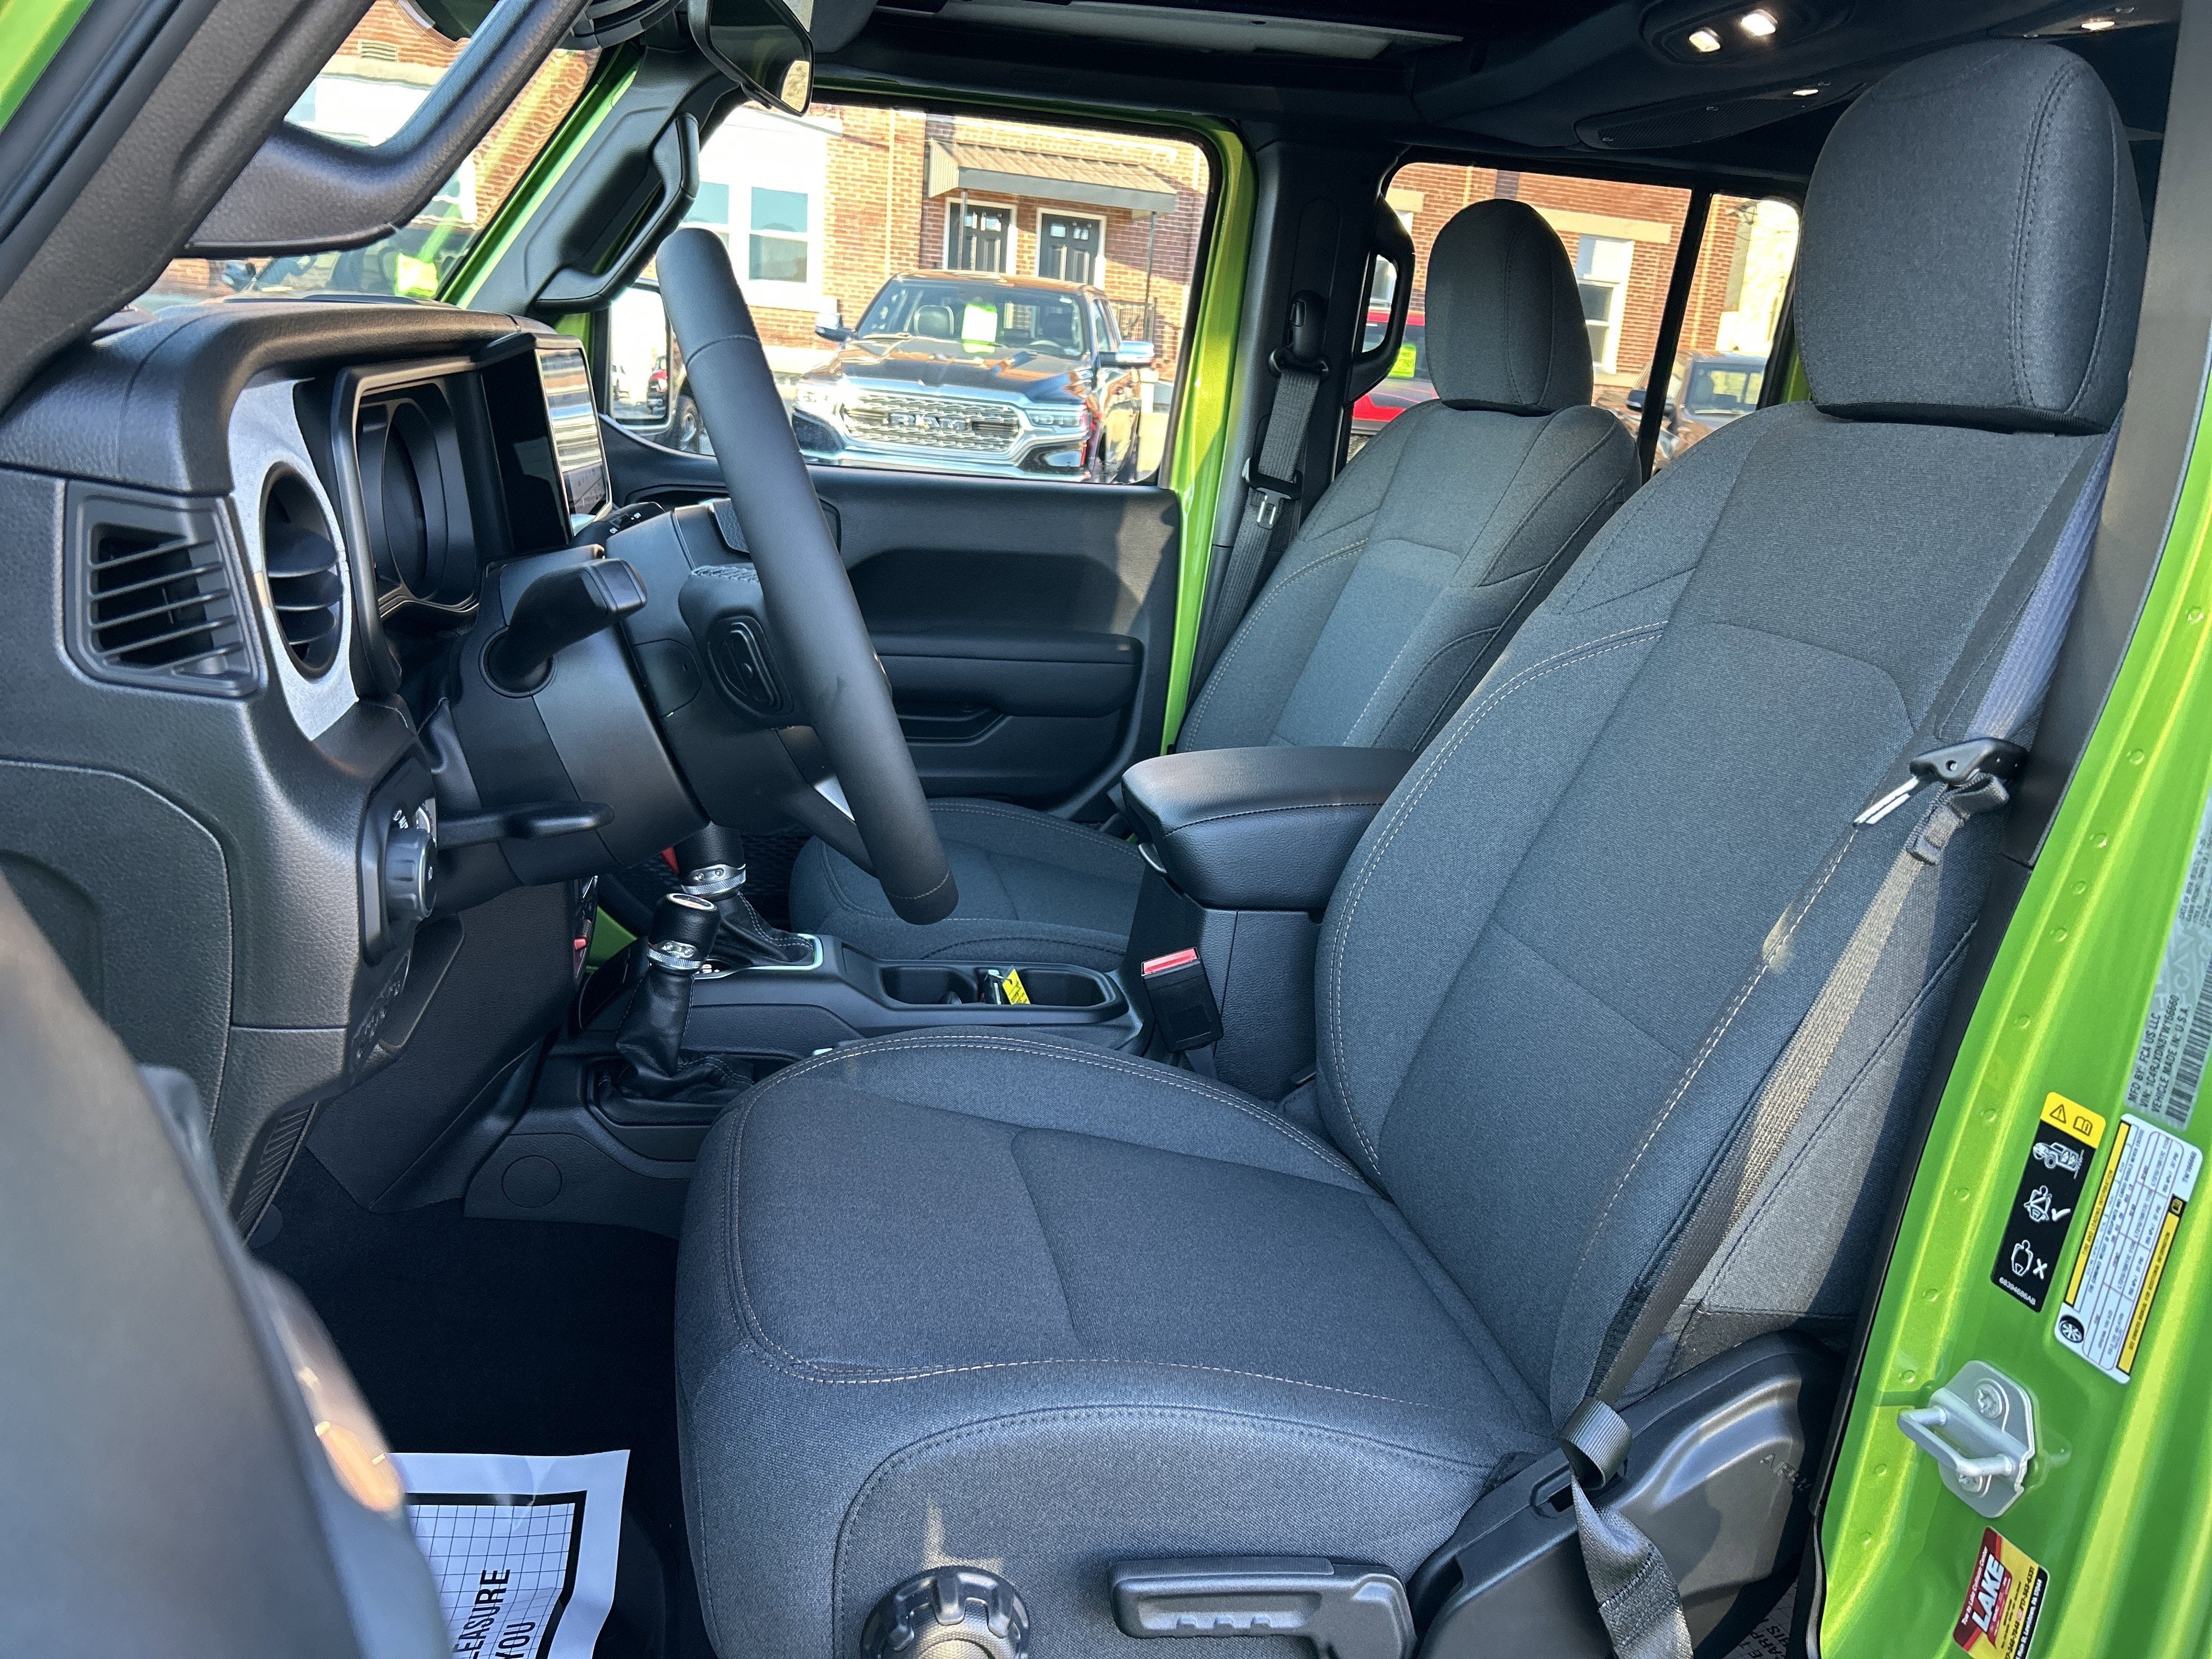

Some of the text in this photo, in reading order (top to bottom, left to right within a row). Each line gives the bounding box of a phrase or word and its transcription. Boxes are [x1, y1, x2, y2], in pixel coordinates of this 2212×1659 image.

[890, 413, 973, 431] RAM
[2148, 1012, 2161, 1030] LLC
[2144, 1030, 2155, 1044] US
[2138, 1045, 2151, 1063] FCA
[2151, 1076, 2169, 1113] VEHICLE
[2162, 1049, 2177, 1075] MADE
[2175, 1004, 2190, 1032] U.S.A.
[2128, 1081, 2141, 1103] MFD
[2140, 1089, 2152, 1108] VIN:
[1967, 1590, 1976, 1606] Lake
[1972, 1553, 2005, 1632] LAKE
[453, 1569, 510, 1659] EASURE
[495, 1622, 535, 1659] YOU
